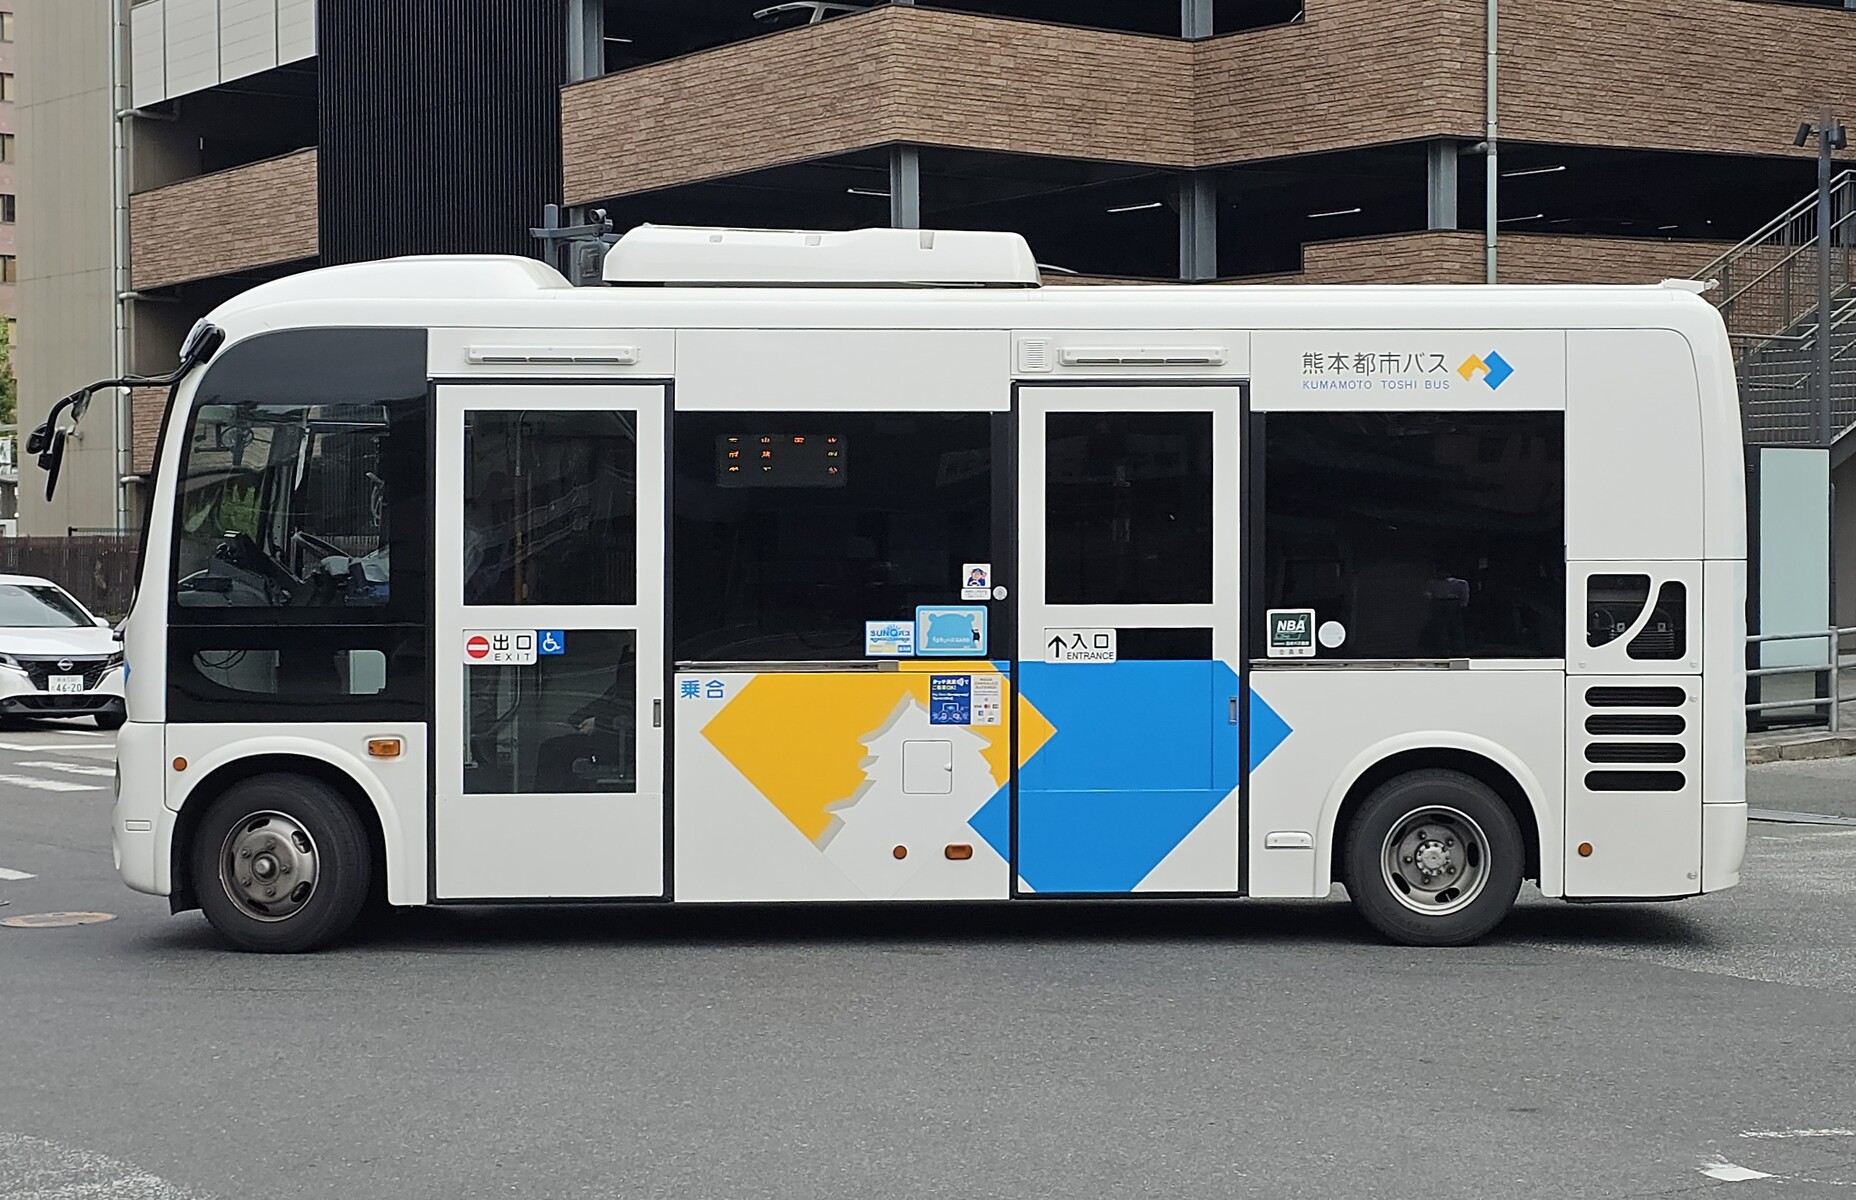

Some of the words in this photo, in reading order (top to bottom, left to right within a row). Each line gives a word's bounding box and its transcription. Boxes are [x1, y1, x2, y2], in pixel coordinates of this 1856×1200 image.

[1302, 352, 1449, 376] 熊本都市バス
[1302, 380, 1372, 390] KUMAMOTO
[1381, 380, 1417, 390] TOSHI
[1425, 380, 1450, 390] BUS
[1277, 620, 1305, 631] NBA
[493, 634, 532, 650] 出口
[1071, 633, 1109, 649] 入口
[494, 653, 531, 661] EXIT
[1066, 652, 1114, 660] ENTRANCE
[56, 684, 82, 692] 46-20
[681, 680, 725, 699] 乗合
